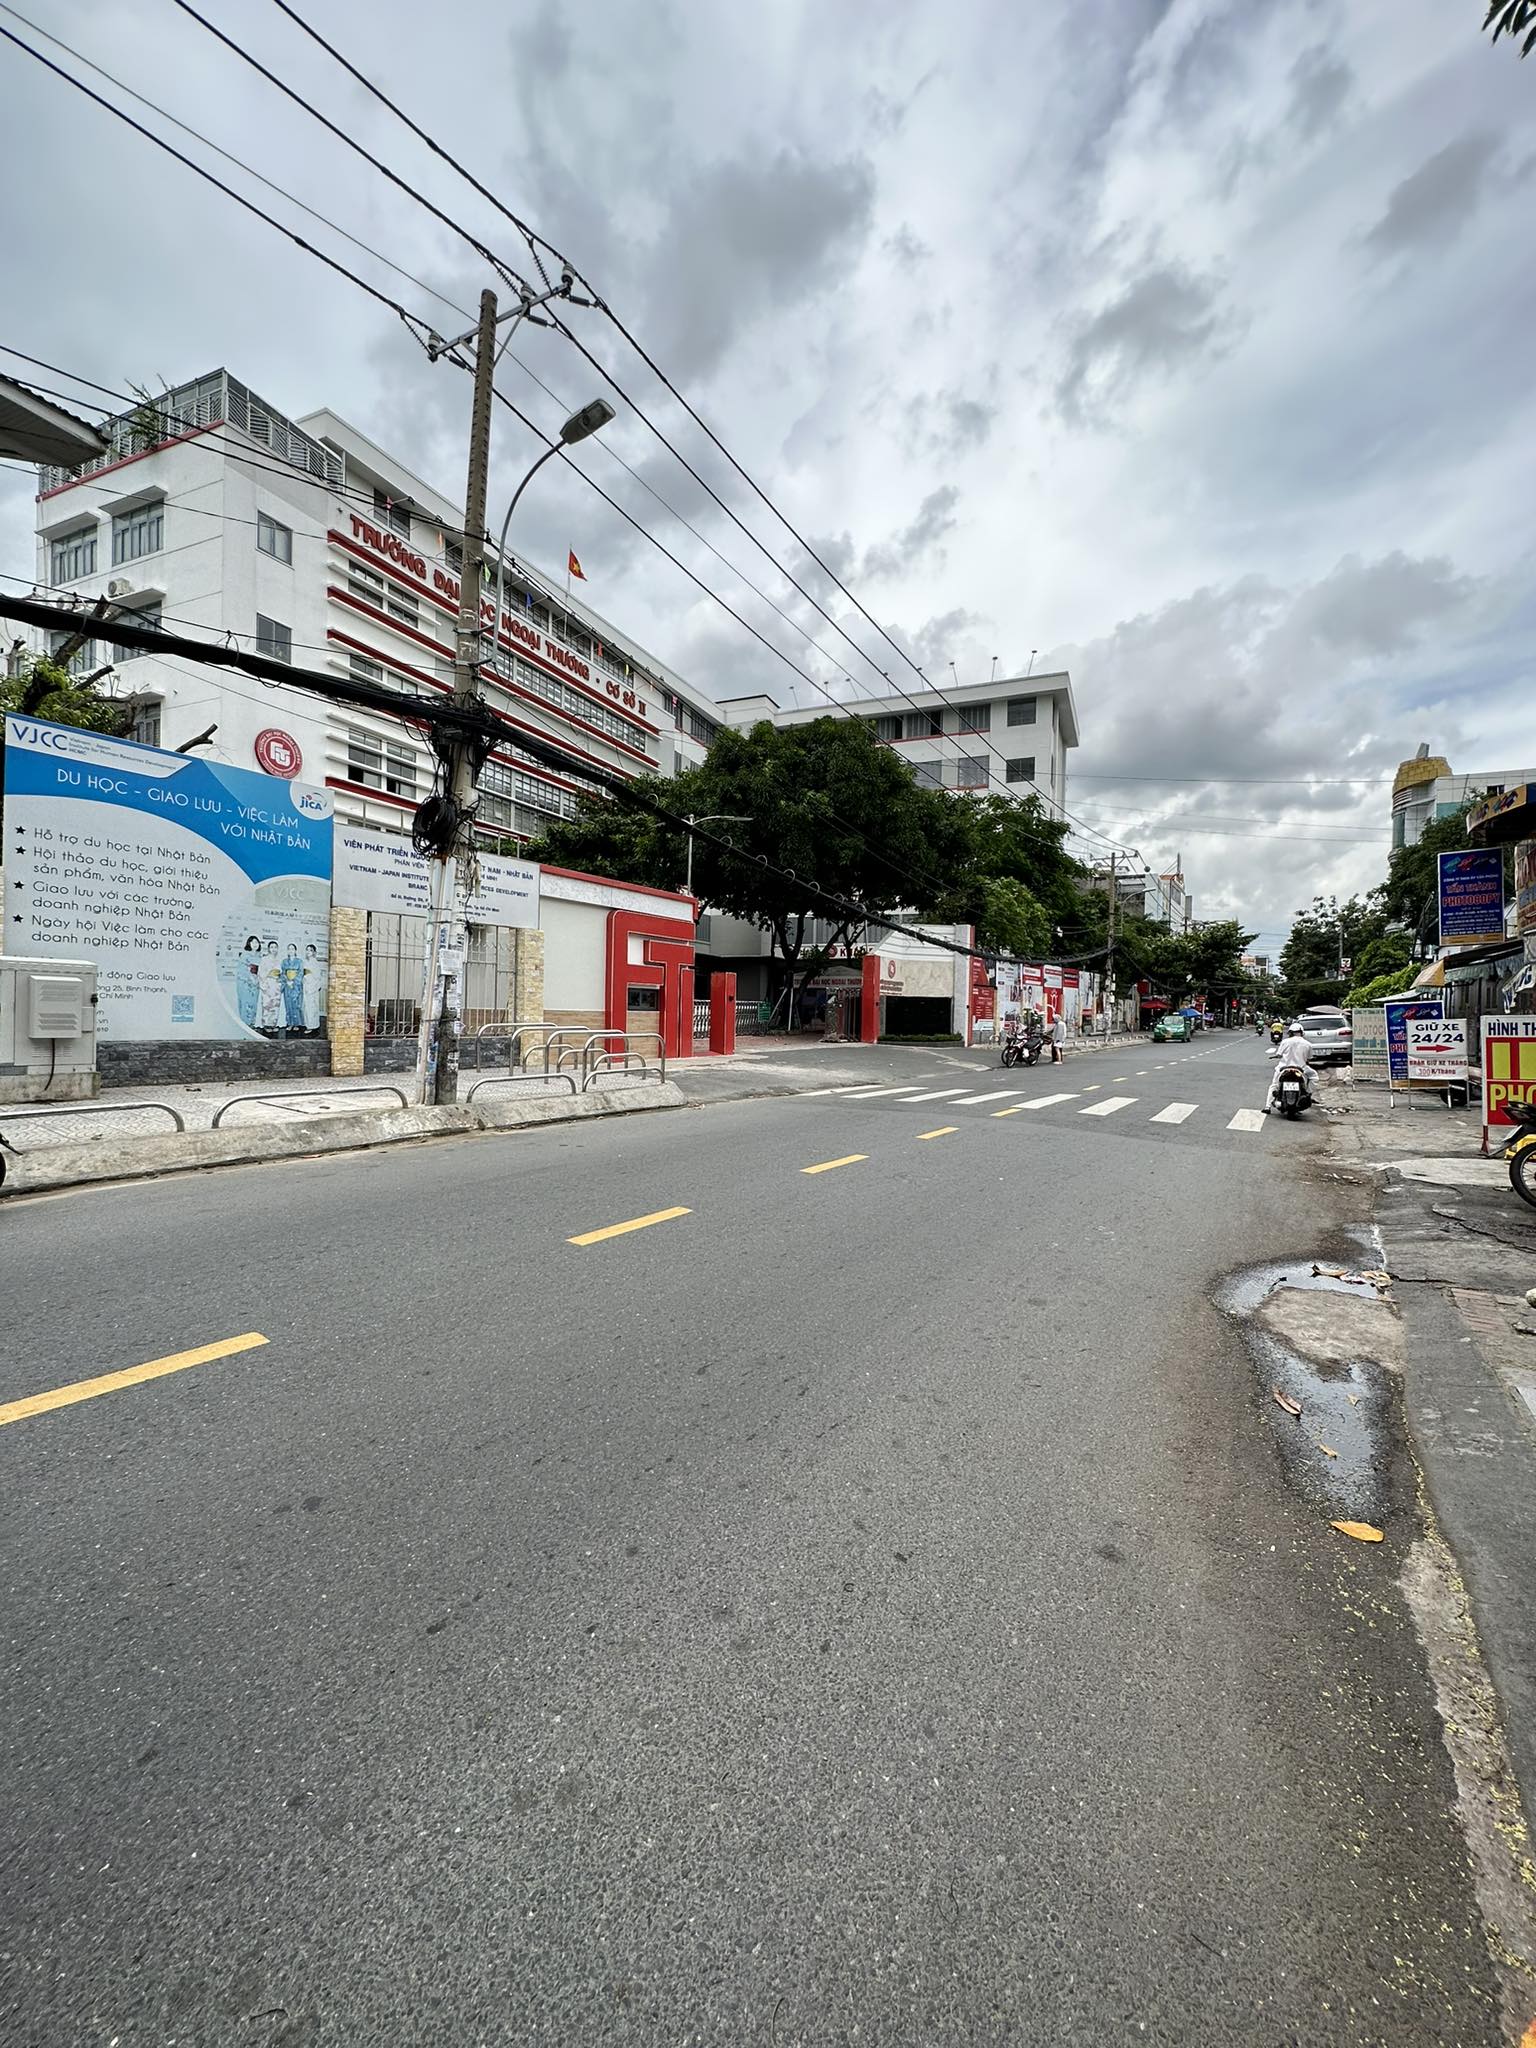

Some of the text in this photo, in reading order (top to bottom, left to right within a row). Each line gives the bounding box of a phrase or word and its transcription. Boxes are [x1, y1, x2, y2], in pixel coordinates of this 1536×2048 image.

[350, 513, 427, 580] TRƯỜNG
[502, 613, 541, 651] NGOẠI
[12, 722, 68, 751] VJCC
[58, 768, 81, 785] DU
[88, 775, 128, 793] HỌC
[147, 788, 189, 807] GIAO
[194, 797, 222, 814] LƯU
[238, 806, 269, 823] VIỆC
[273, 814, 299, 829] LÀM
[221, 822, 246, 838] VỚI
[251, 829, 283, 846] NHẬT
[84, 837, 101, 848] du
[107, 839, 131, 852] học
[100, 857, 117, 868] du
[349, 864, 377, 874] VIETNAM
[33, 880, 69, 895] Giao
[408, 883, 428, 891] BRANC
[32, 897, 78, 910] doanh
[32, 914, 70, 930] Ngày
[160, 927, 182, 938] cho
[31, 931, 78, 943] doanh
[136, 972, 160, 981] Giao
[1488, 1019, 1519, 1036] HÌNH
[1411, 1034, 1464, 1043] 24/24
